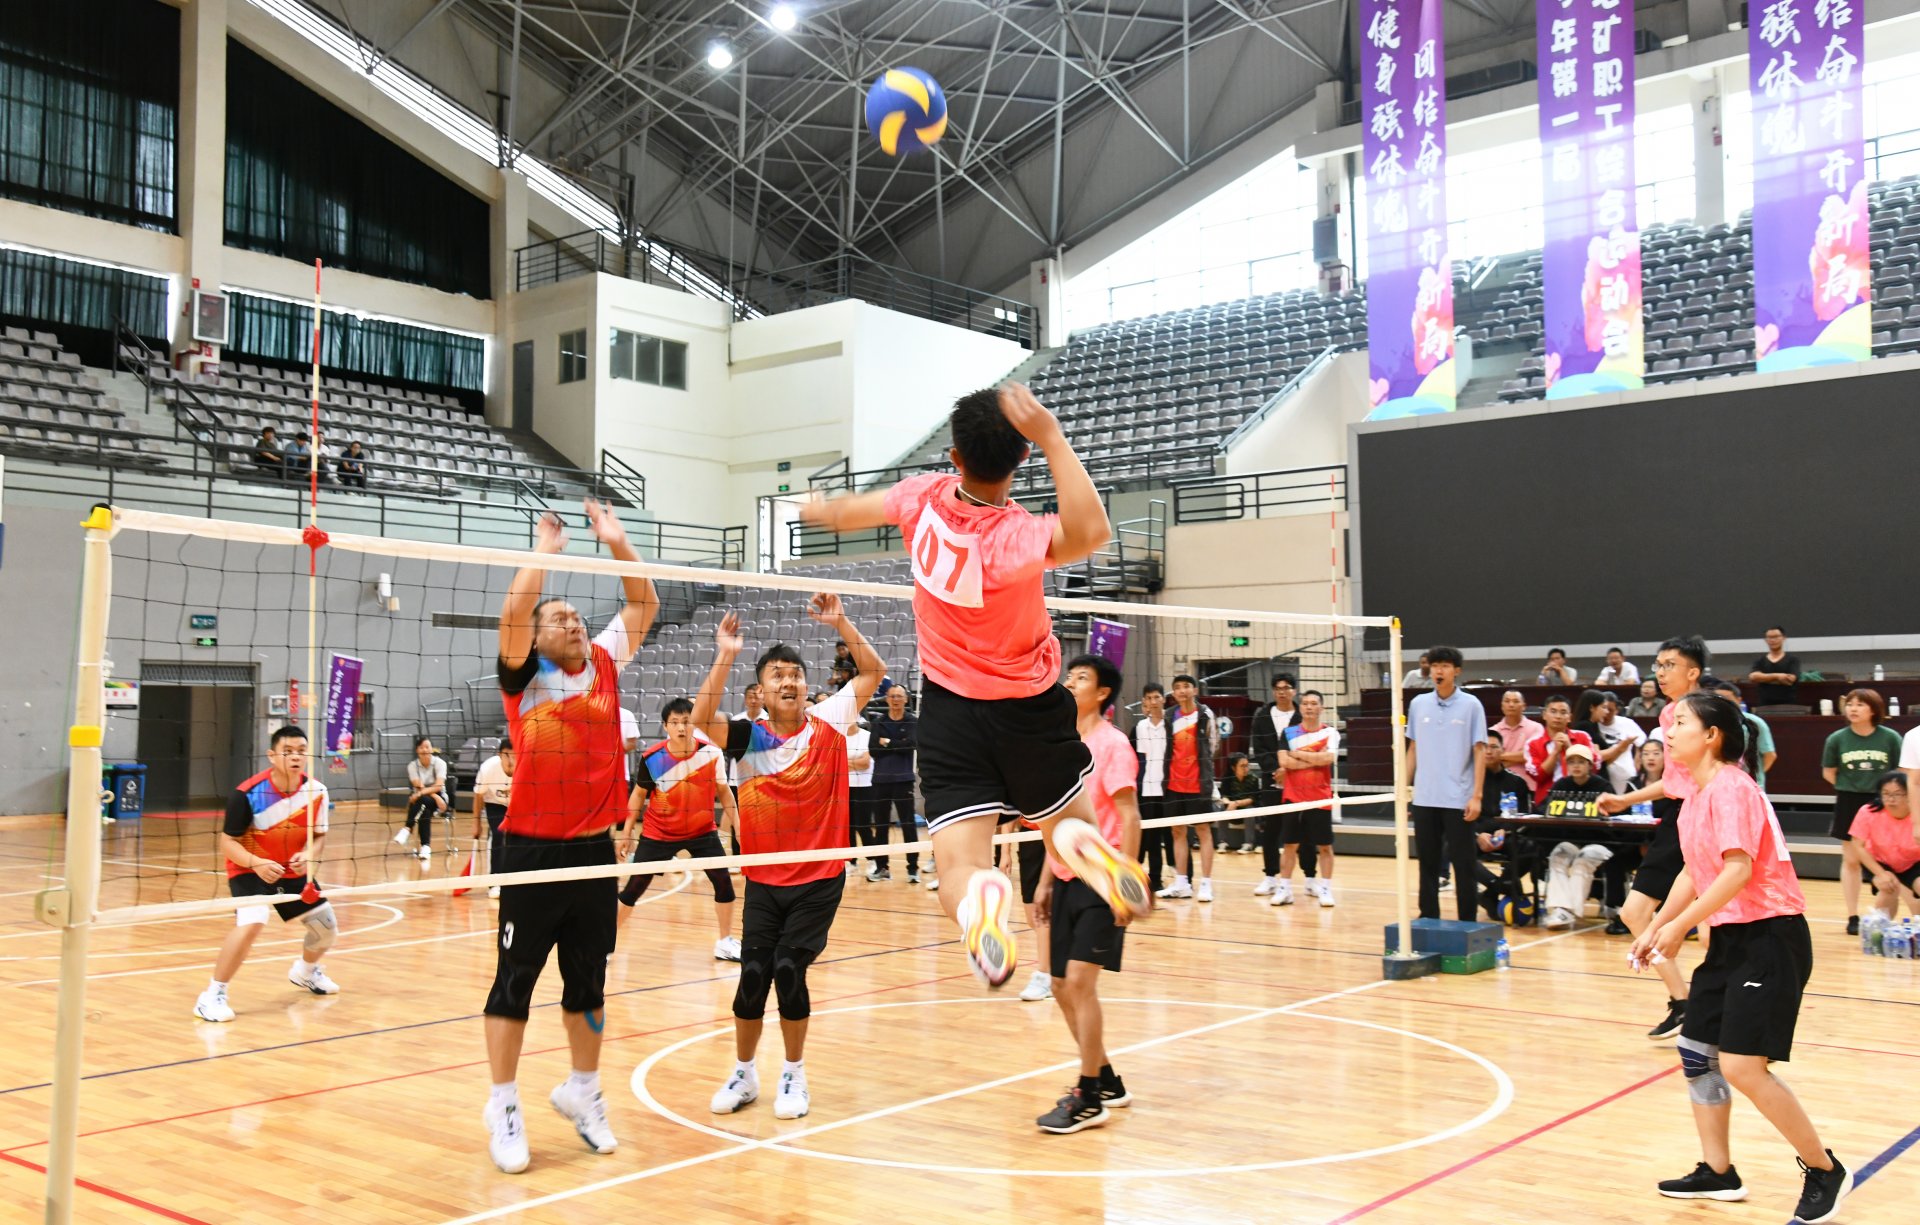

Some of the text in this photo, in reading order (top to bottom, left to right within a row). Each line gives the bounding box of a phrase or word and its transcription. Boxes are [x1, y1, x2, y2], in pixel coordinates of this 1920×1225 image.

[1367, 0, 1408, 233] 健身强体魄
[1550, 0, 1582, 183] 年第一届
[1591, 0, 1630, 358] 矿职工综合运动会
[916, 523, 969, 594] 07
[1549, 800, 1567, 816] 17
